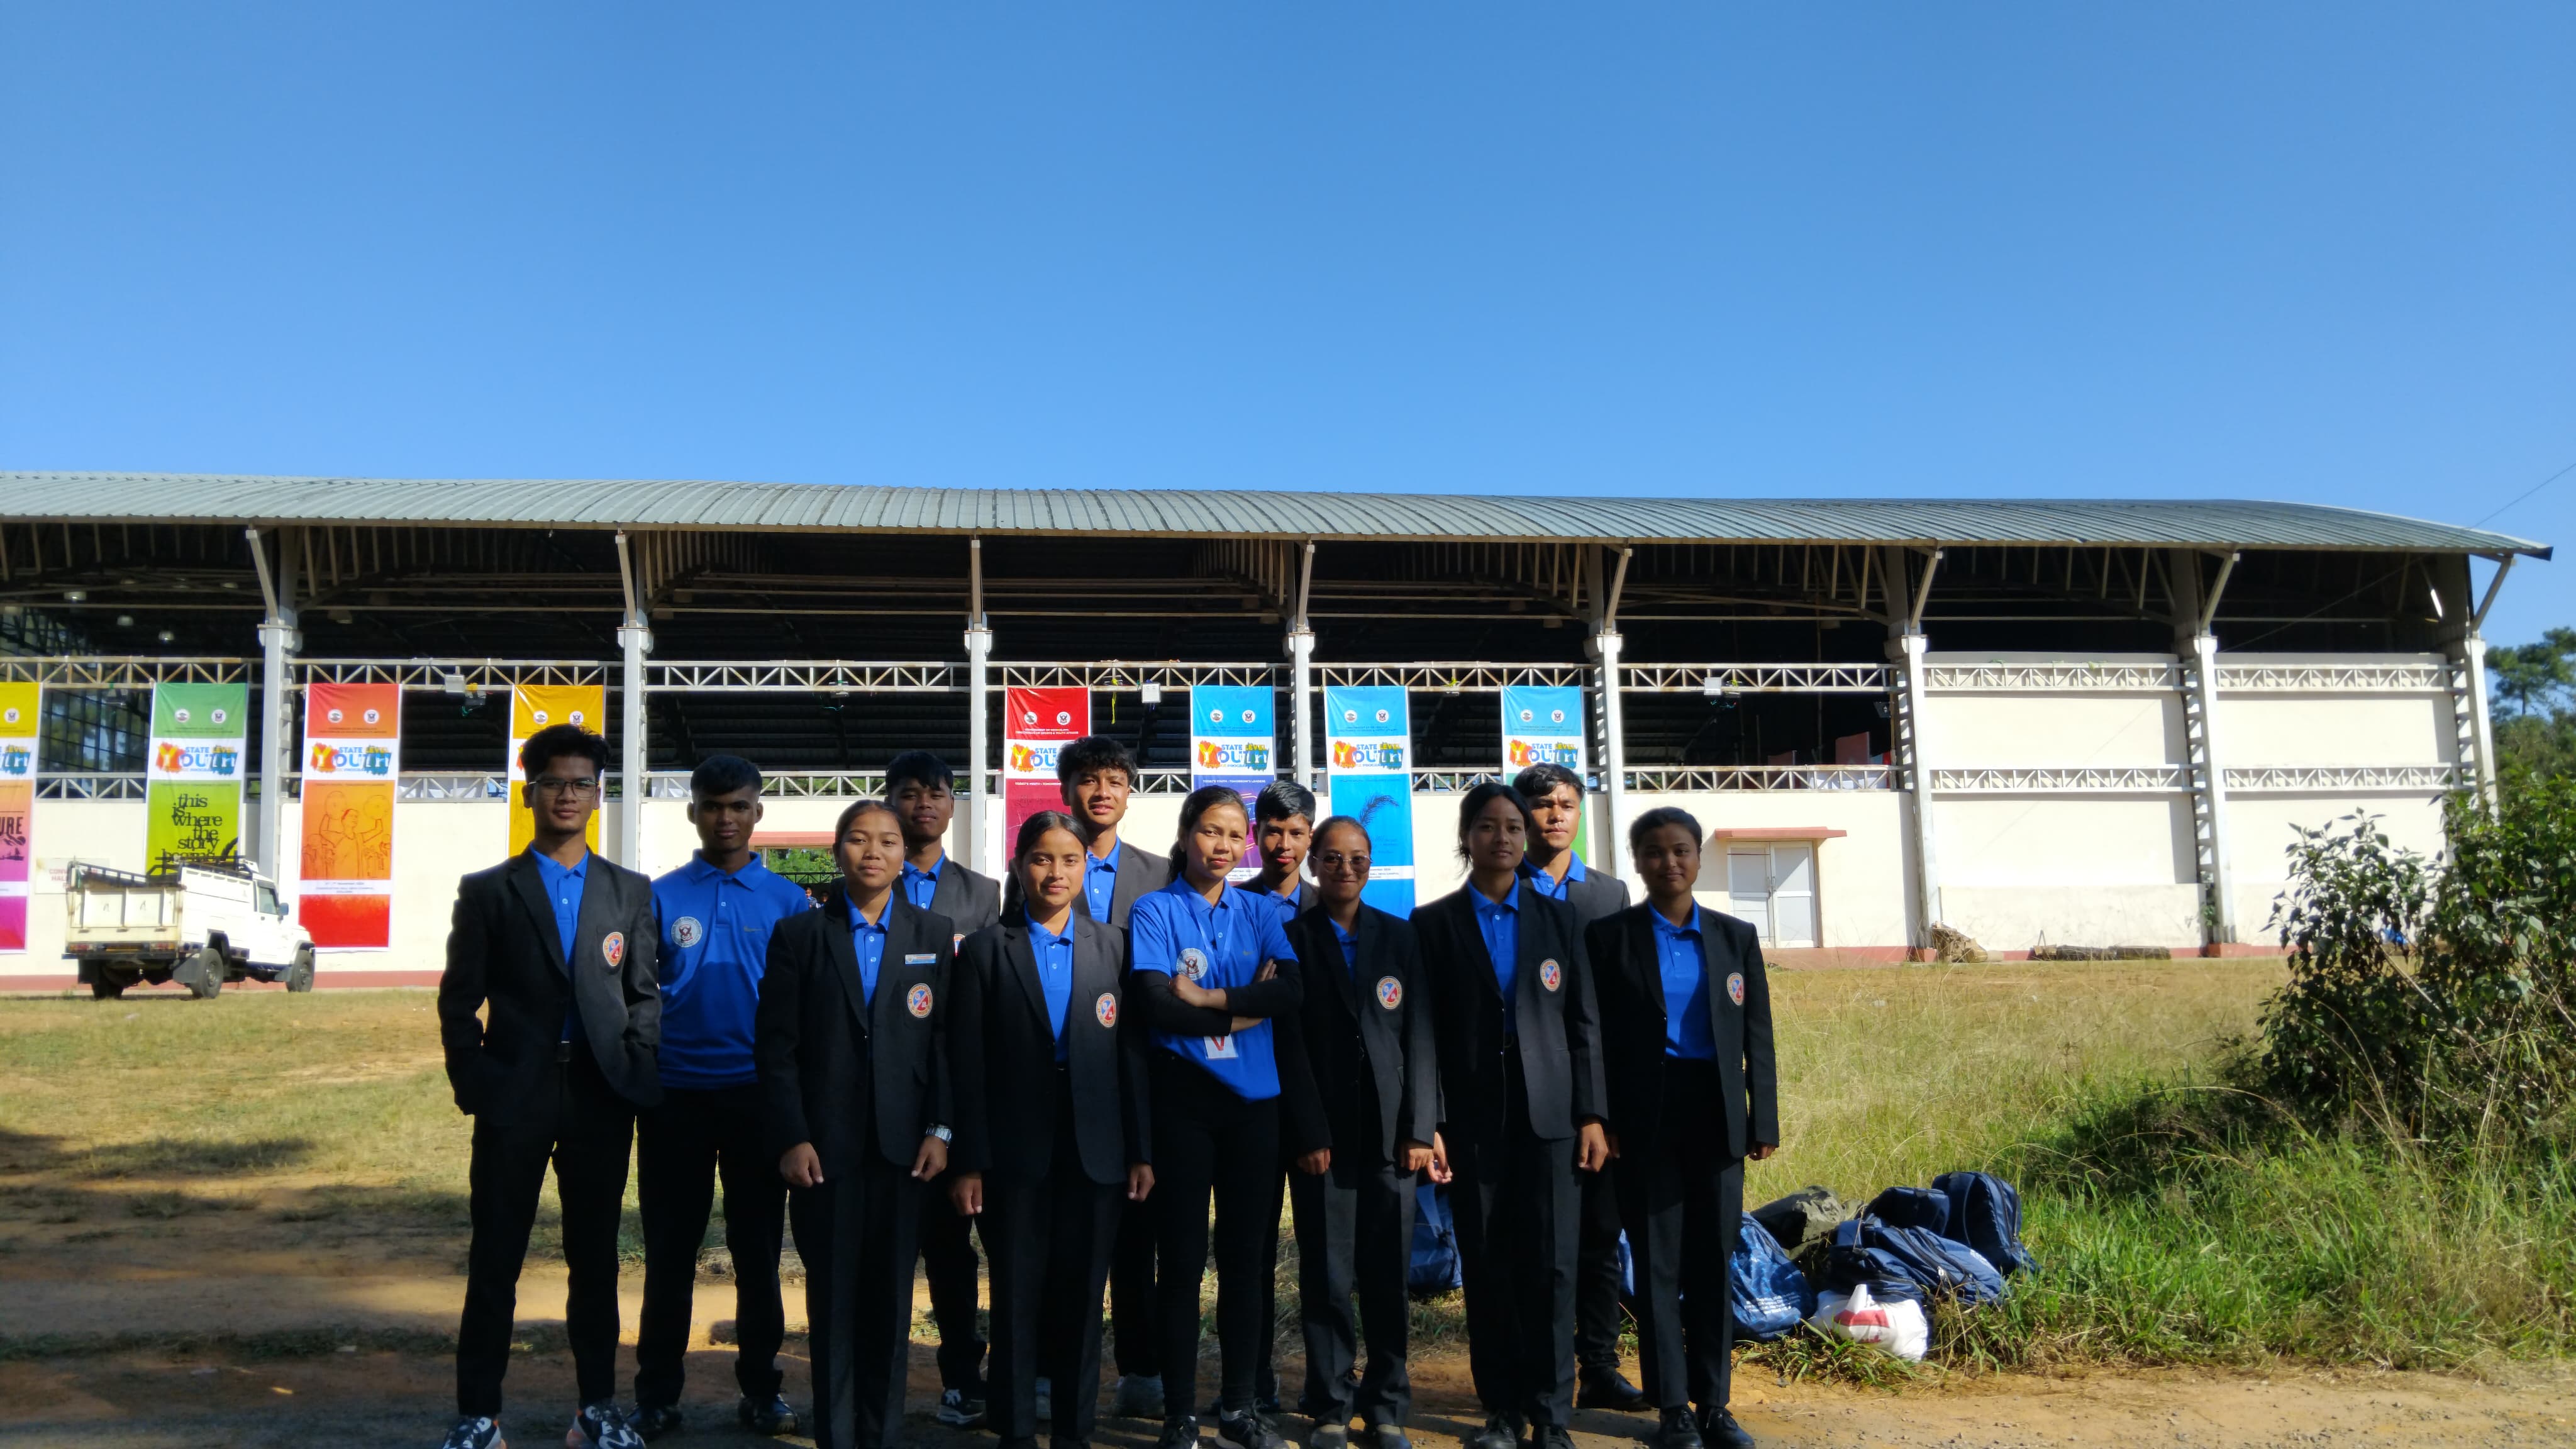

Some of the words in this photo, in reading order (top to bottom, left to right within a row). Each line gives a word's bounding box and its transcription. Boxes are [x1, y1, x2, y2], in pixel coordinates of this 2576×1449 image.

[1010, 746, 1057, 767] YOU
[1198, 743, 1268, 763] YOUTH
[1333, 743, 1402, 763] YOUTH
[178, 793, 208, 808] this
[172, 802, 186, 818] is
[171, 812, 223, 827] where
[192, 824, 219, 842] the
[177, 836, 220, 853] story
